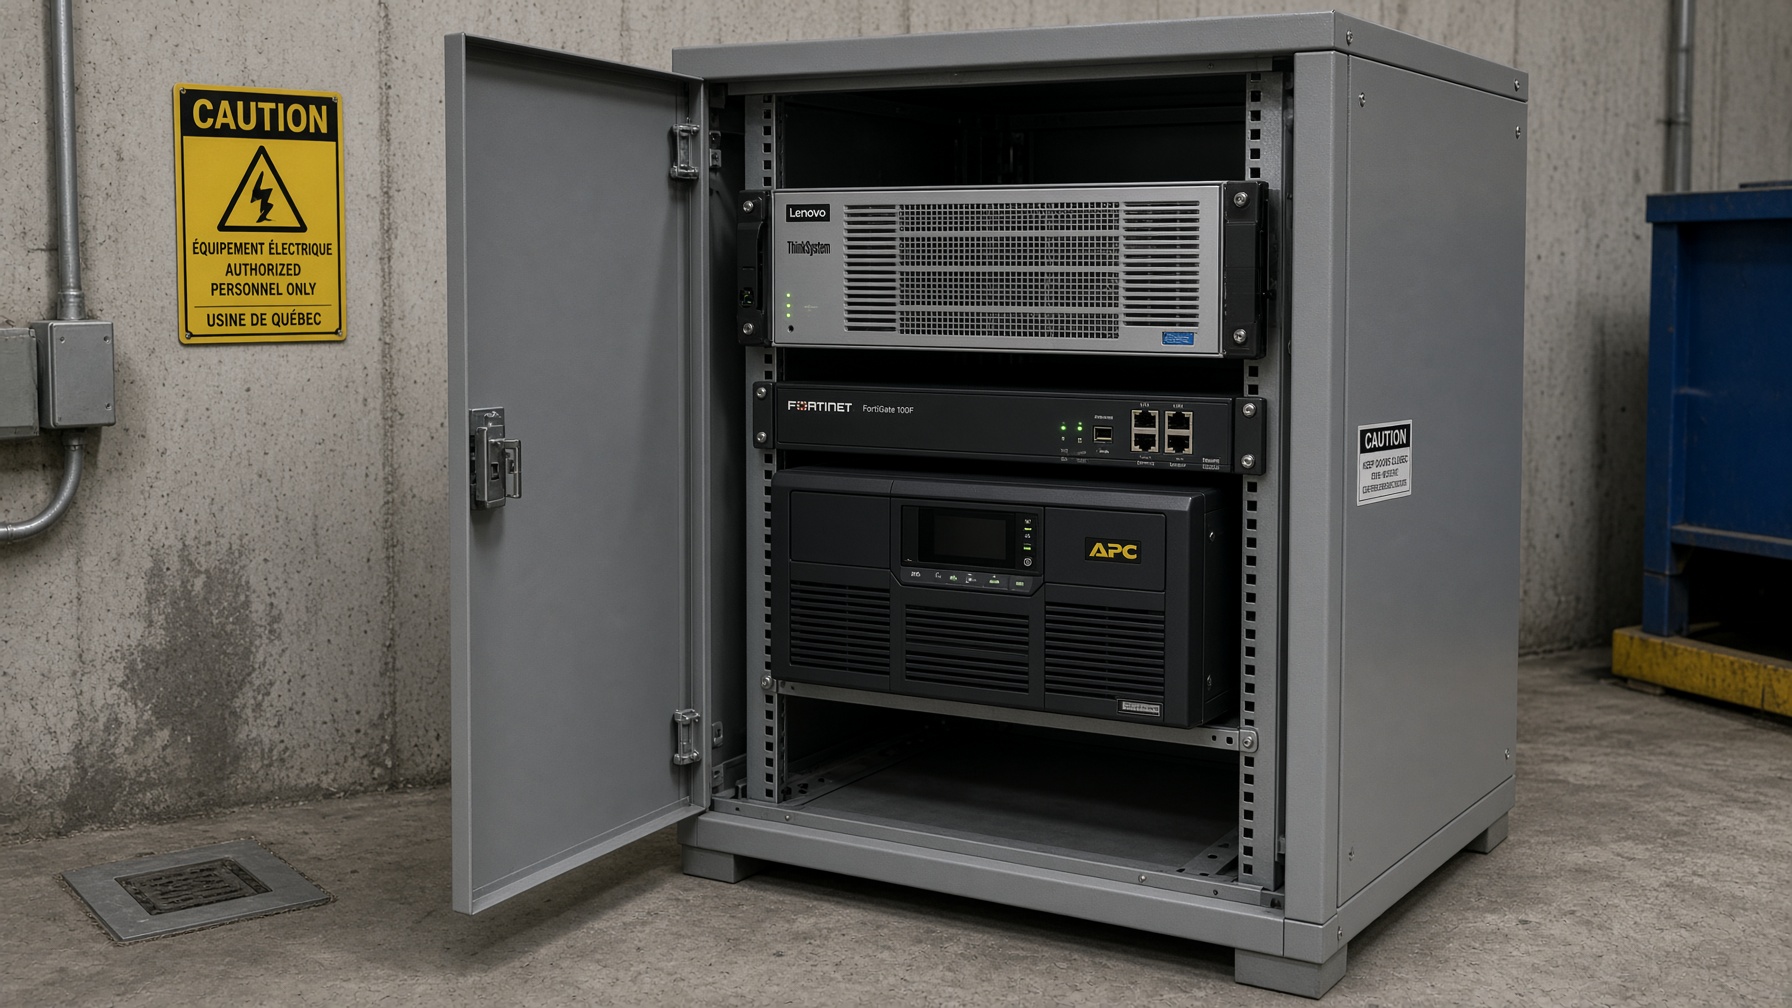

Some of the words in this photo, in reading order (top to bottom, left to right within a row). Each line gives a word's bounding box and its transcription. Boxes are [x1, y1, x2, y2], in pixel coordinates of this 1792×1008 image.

[192, 98, 328, 134] CAUTION
[789, 207, 826, 218] Lenovo
[192, 238, 265, 256] ÉQUIPEMENT
[268, 239, 333, 257] ÉLECTRIQUE
[787, 240, 831, 256] ThinkSystem
[225, 262, 301, 277] AUTHORIZED
[210, 282, 283, 296] PERSONNEL
[286, 282, 317, 296] ONLY
[206, 313, 246, 327] USINE
[250, 313, 267, 326] DE
[271, 309, 322, 328] QUÉBEC
[787, 400, 853, 413] FORTINET
[862, 404, 896, 414] FortiGate
[897, 406, 914, 414] 100F
[1364, 428, 1407, 450] CAUTION
[1088, 542, 1138, 560] APC
